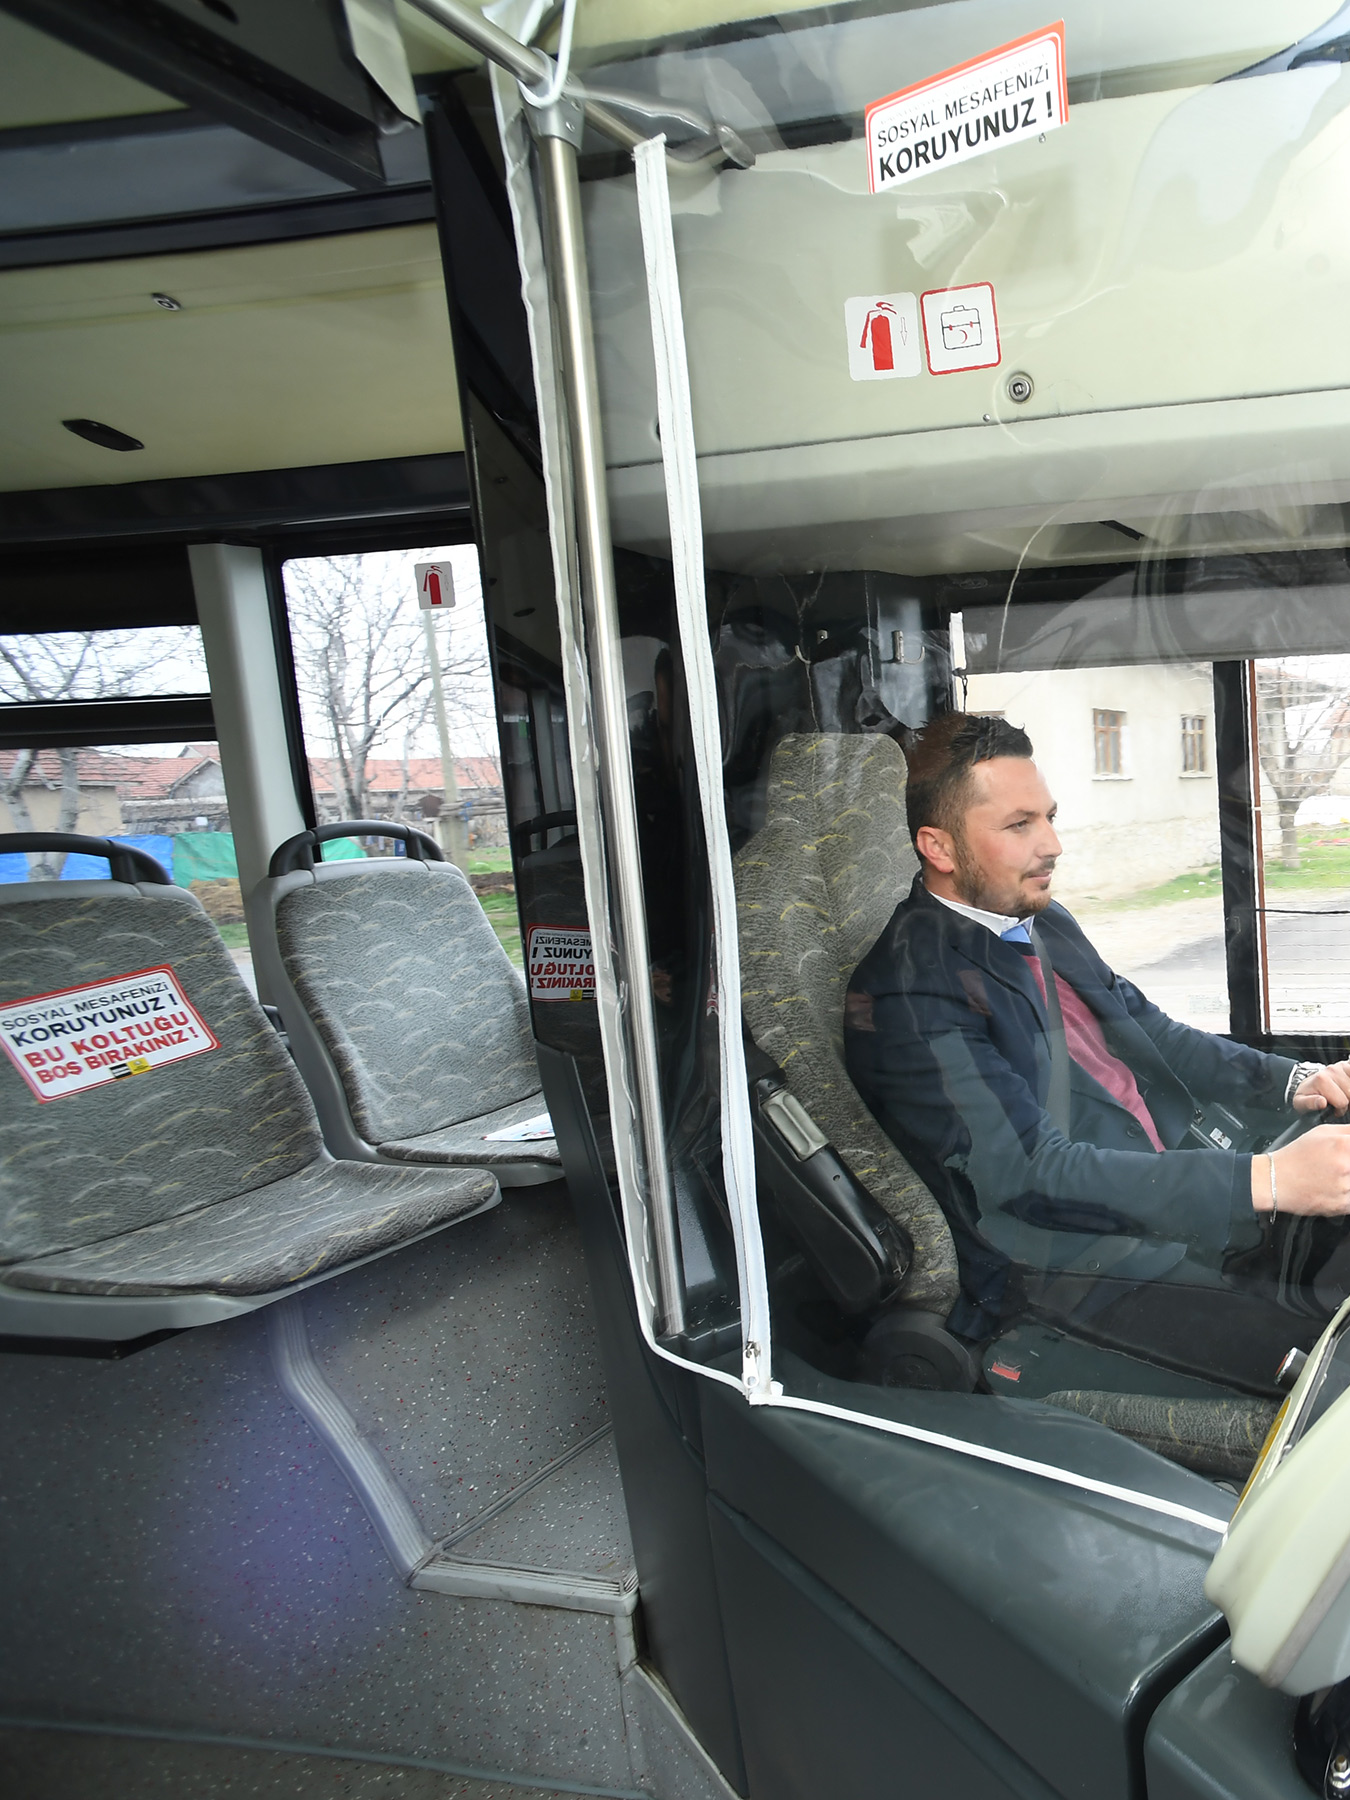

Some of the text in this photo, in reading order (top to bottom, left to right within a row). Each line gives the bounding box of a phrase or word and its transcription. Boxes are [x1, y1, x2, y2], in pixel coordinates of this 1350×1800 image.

[878, 110, 940, 147] SOSYAL
[880, 97, 1037, 182] KORUYUNUZ
[2, 1008, 72, 1030] SOSYAL
[10, 996, 166, 1048] KORUYUNUZ
[24, 1011, 190, 1068] BU KOLTUĞU
[36, 1061, 84, 1084] BOŞ
[84, 1030, 189, 1070] BIRAKINIZ
